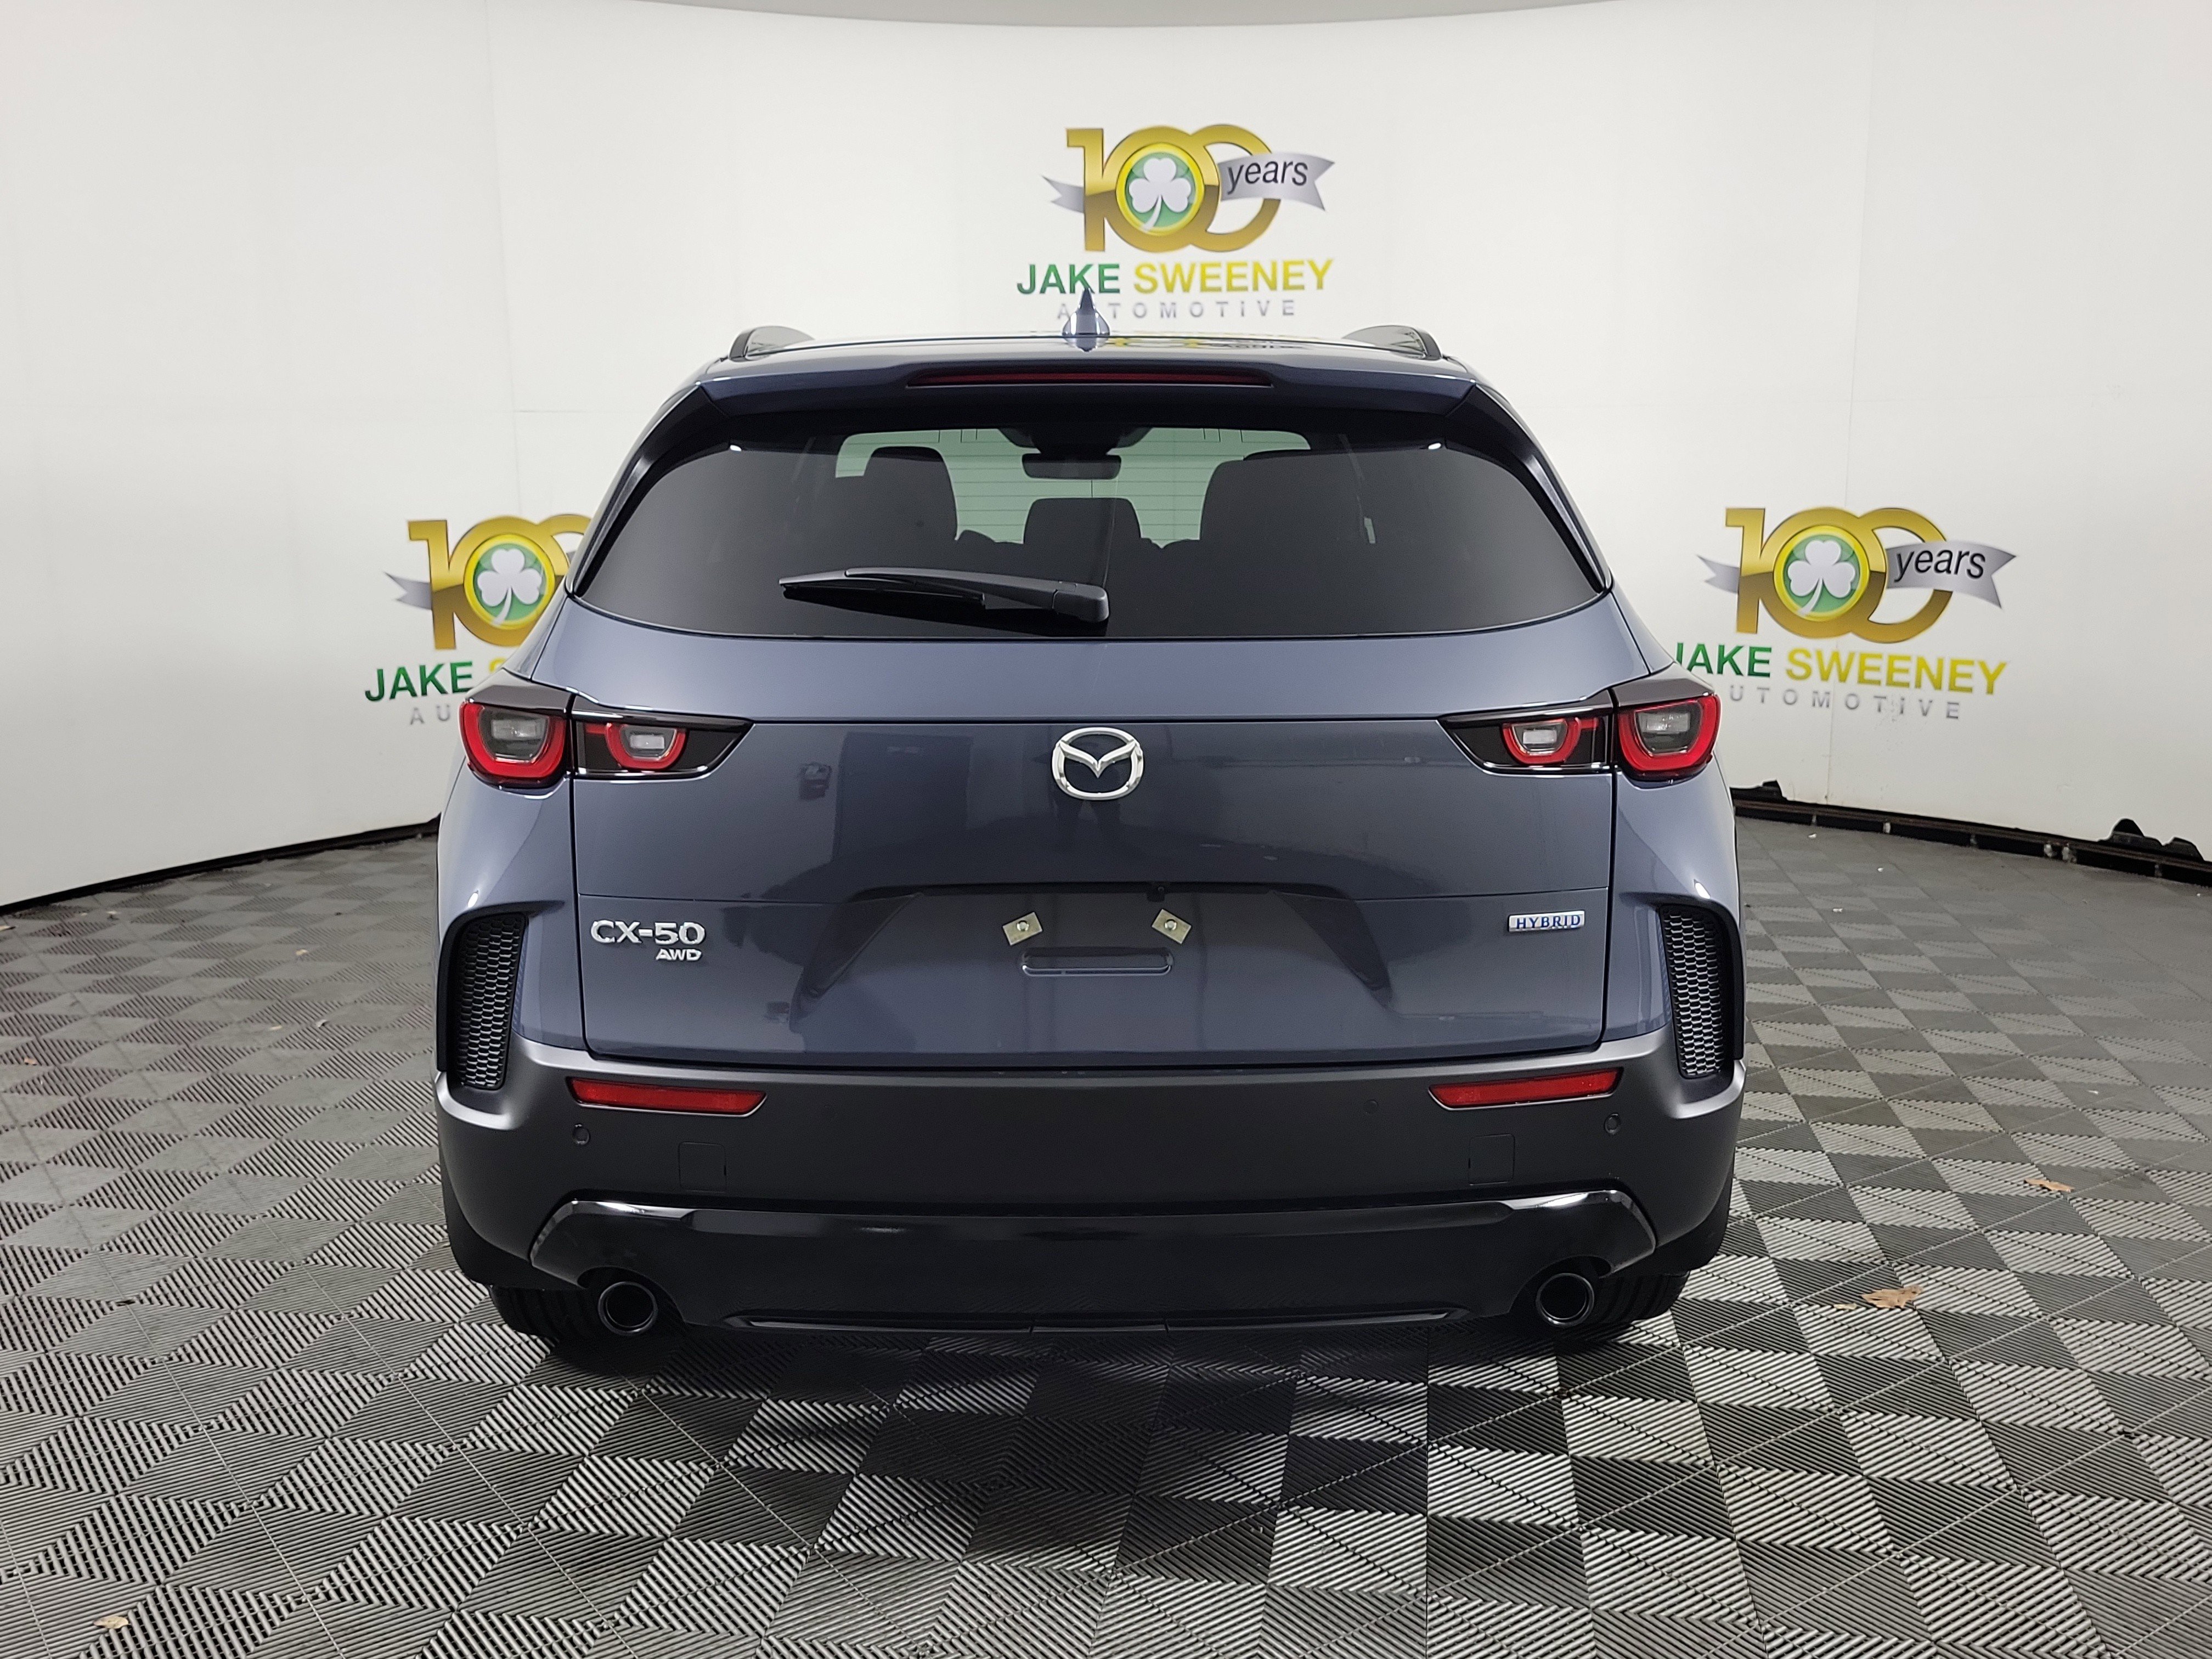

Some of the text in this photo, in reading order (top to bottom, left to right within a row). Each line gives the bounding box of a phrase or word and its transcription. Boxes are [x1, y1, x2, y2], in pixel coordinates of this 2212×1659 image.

[1226, 160, 1309, 195] years
[1017, 259, 1334, 295] JAKE SWEENEY
[1057, 300, 1295, 320] ATOMOTIVE
[1893, 548, 1987, 582] years
[364, 660, 473, 702] JAKE
[1785, 647, 2007, 696] SWEENEY
[1730, 685, 1960, 720] UTOMOTIVE
[591, 919, 706, 945] CX-50
[1516, 915, 1581, 929] HYBRID
[656, 948, 702, 961] AWD
